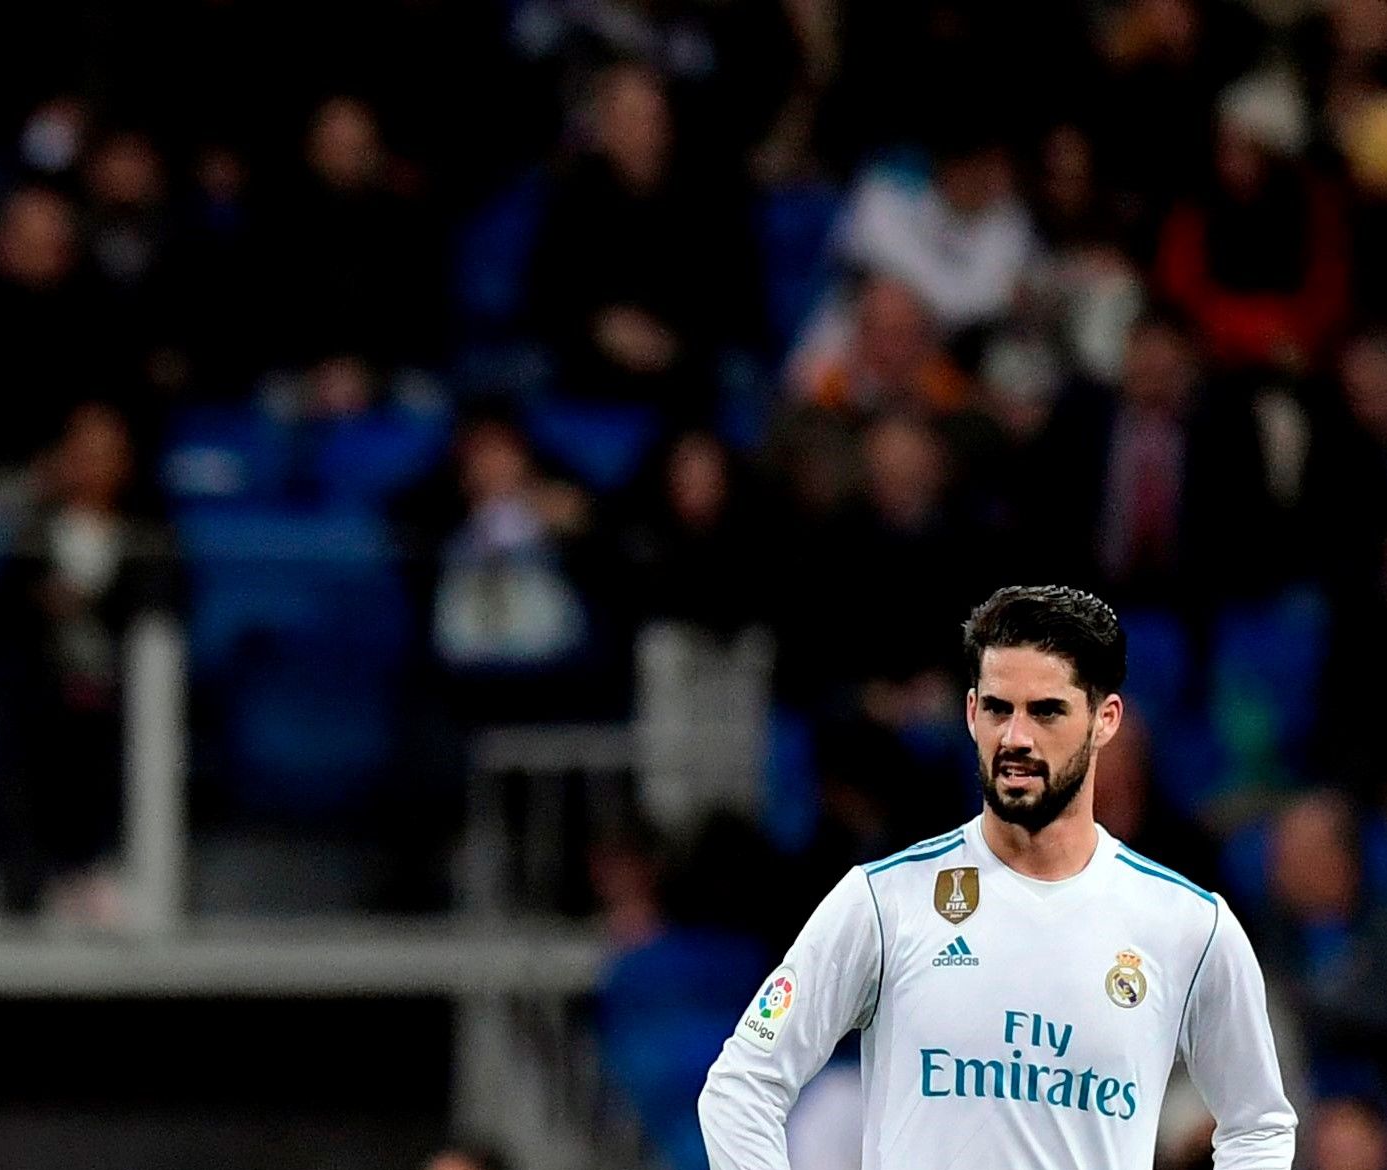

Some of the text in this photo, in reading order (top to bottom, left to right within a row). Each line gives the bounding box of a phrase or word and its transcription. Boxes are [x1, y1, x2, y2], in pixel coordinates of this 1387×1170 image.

[946, 901, 968, 911] FIFA
[932, 955, 980, 967] adidas
[1003, 1010, 1073, 1057] Fly
[919, 1048, 1136, 1120] Emirates
